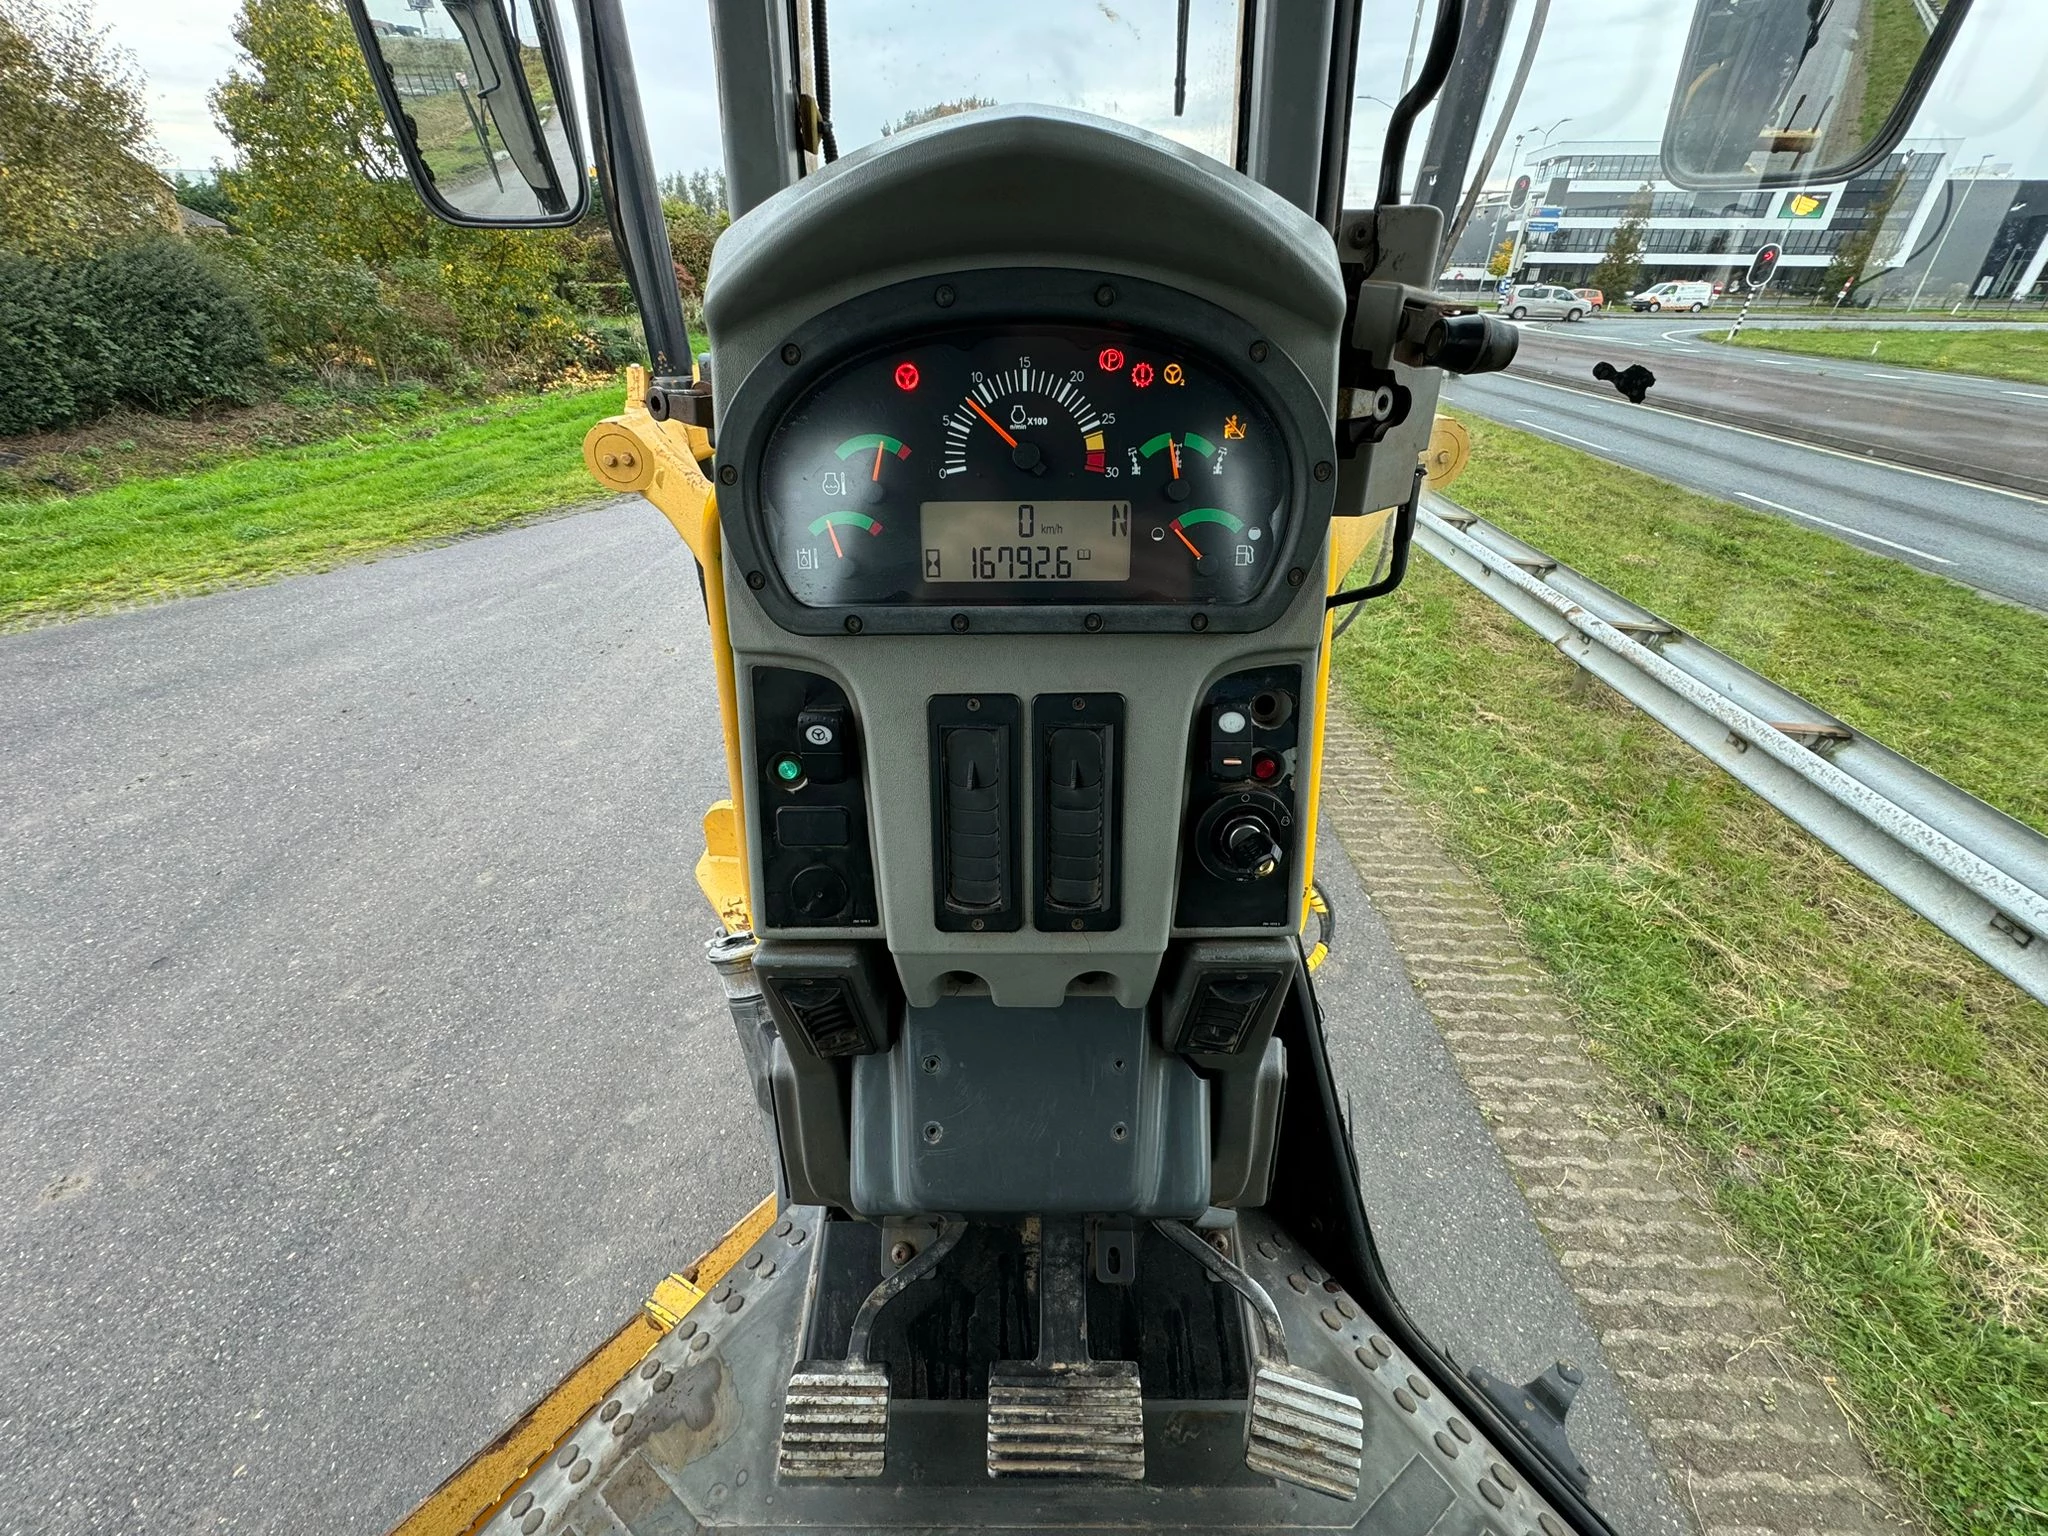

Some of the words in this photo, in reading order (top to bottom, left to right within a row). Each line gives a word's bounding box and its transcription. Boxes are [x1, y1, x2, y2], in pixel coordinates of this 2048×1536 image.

[1019, 356, 1031, 368] 15
[971, 371, 983, 383] 10
[1070, 371, 1084, 382] 20
[943, 415, 950, 426] 5
[1027, 417, 1048, 426] X100
[1102, 413, 1116, 425] 25
[939, 468, 947, 479] 0
[1105, 467, 1119, 478] 30
[1018, 504, 1034, 538] 0
[1041, 524, 1063, 534] km/h
[1112, 504, 1128, 537] N
[971, 546, 1072, 579] 16792.6
